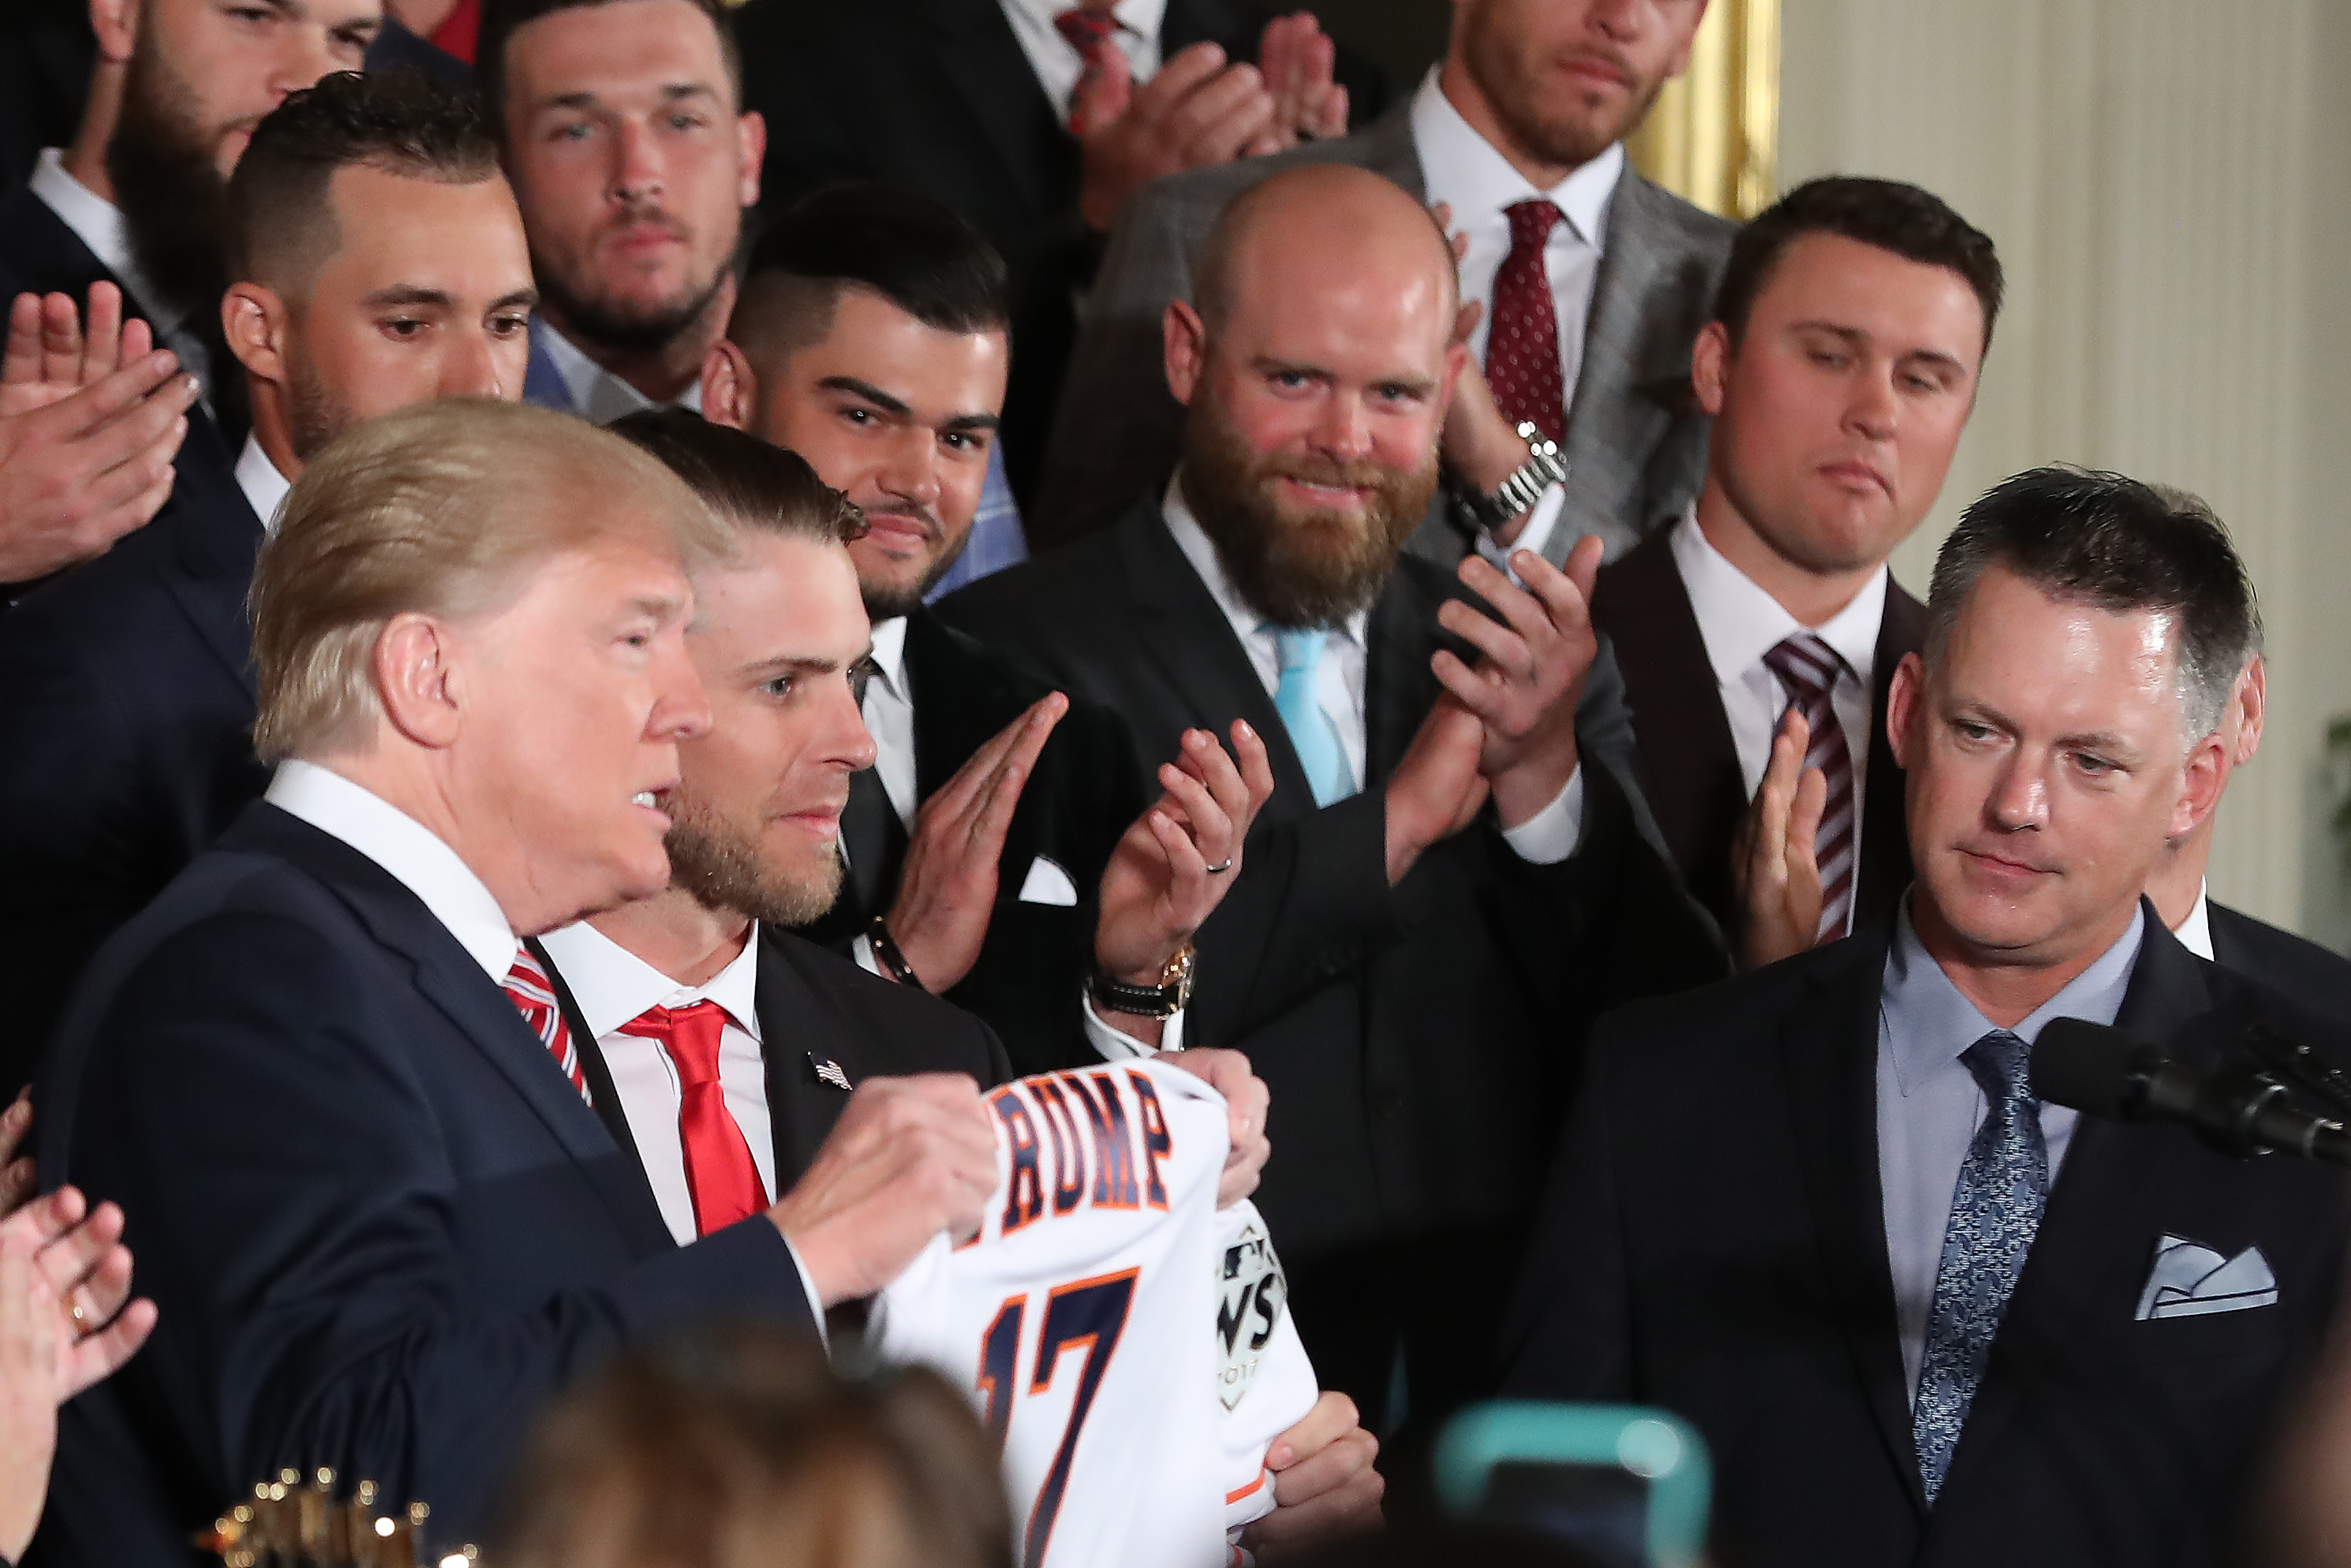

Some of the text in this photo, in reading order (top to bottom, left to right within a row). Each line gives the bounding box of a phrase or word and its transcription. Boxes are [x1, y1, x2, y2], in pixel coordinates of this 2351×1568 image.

[952, 1068, 1172, 1252] RUMP
[977, 1266, 1141, 1568] 17
[1216, 1358, 1260, 1386] 017
